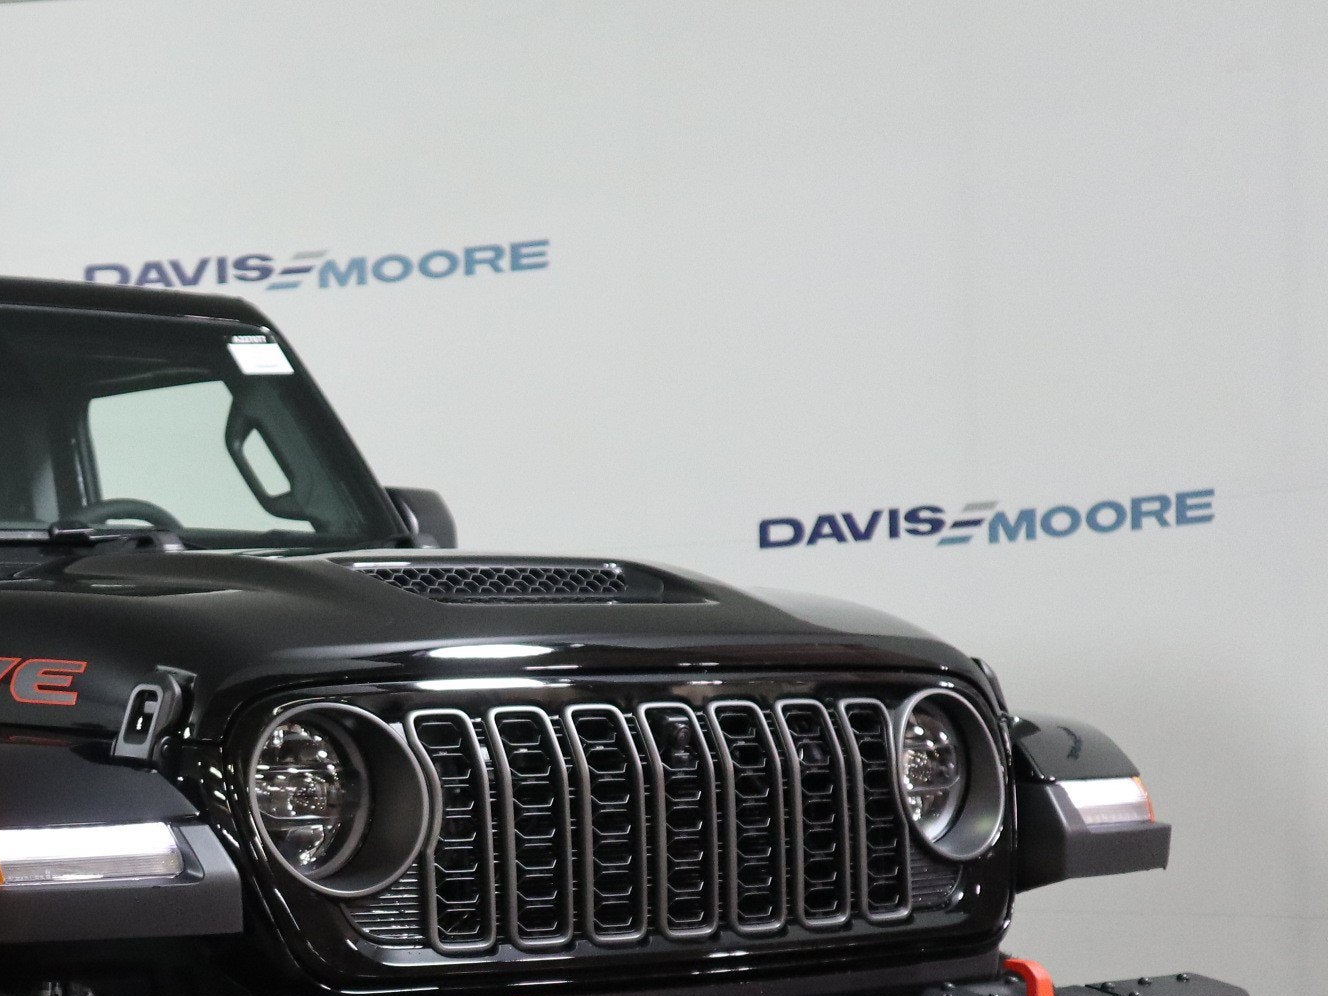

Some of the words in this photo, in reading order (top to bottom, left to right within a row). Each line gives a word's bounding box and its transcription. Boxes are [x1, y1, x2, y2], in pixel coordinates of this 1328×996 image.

[84, 253, 274, 288] DAVIS
[318, 239, 550, 289] MOORE
[758, 505, 947, 550] DAVIS
[987, 488, 1215, 545] MOORE
